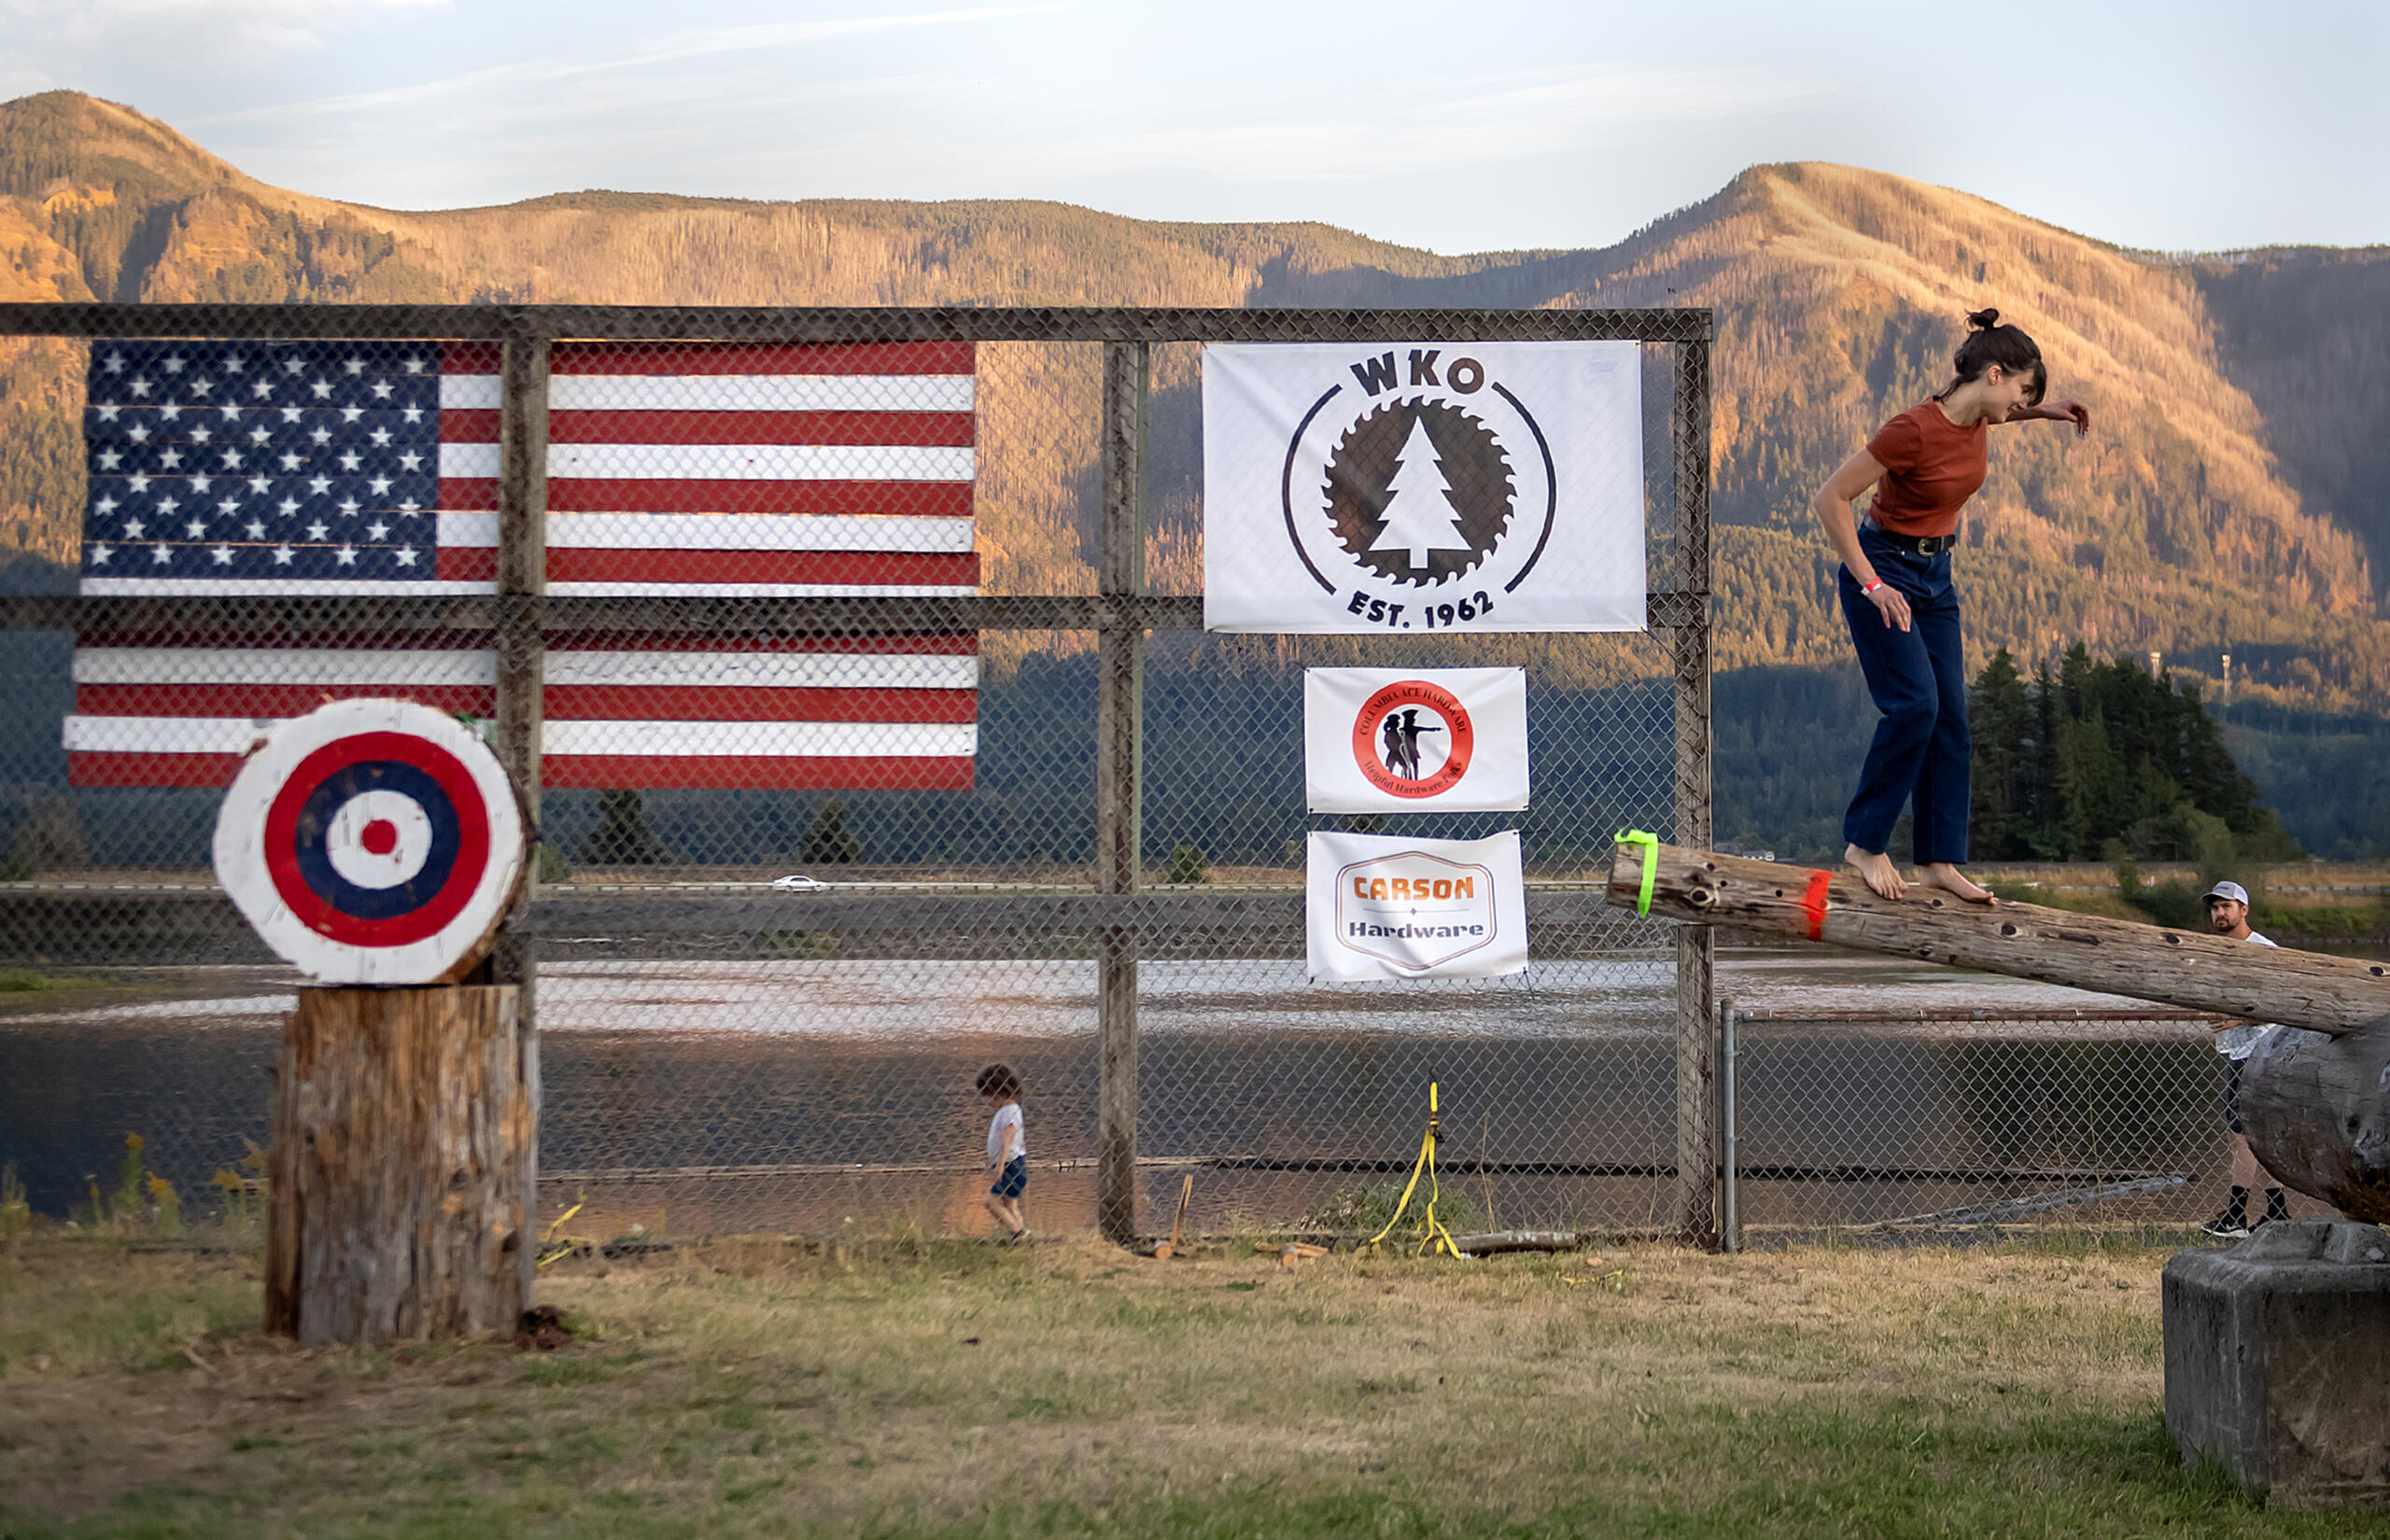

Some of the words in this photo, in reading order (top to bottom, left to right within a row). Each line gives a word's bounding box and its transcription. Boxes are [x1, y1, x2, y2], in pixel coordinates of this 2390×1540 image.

[1350, 349, 1484, 396] WKO
[1347, 590, 1410, 628] EST.
[1425, 591, 1494, 628] 1962
[1359, 691, 1399, 735] COLUMBIA
[1401, 687, 1421, 697] ACE
[1423, 689, 1467, 734] HARDWARE
[1364, 761, 1394, 789] Helpful
[1396, 781, 1442, 794] Hardware
[1442, 761, 1463, 785] Folks
[1354, 875, 1474, 901] CARSON
[1349, 921, 1483, 939] Hardware
